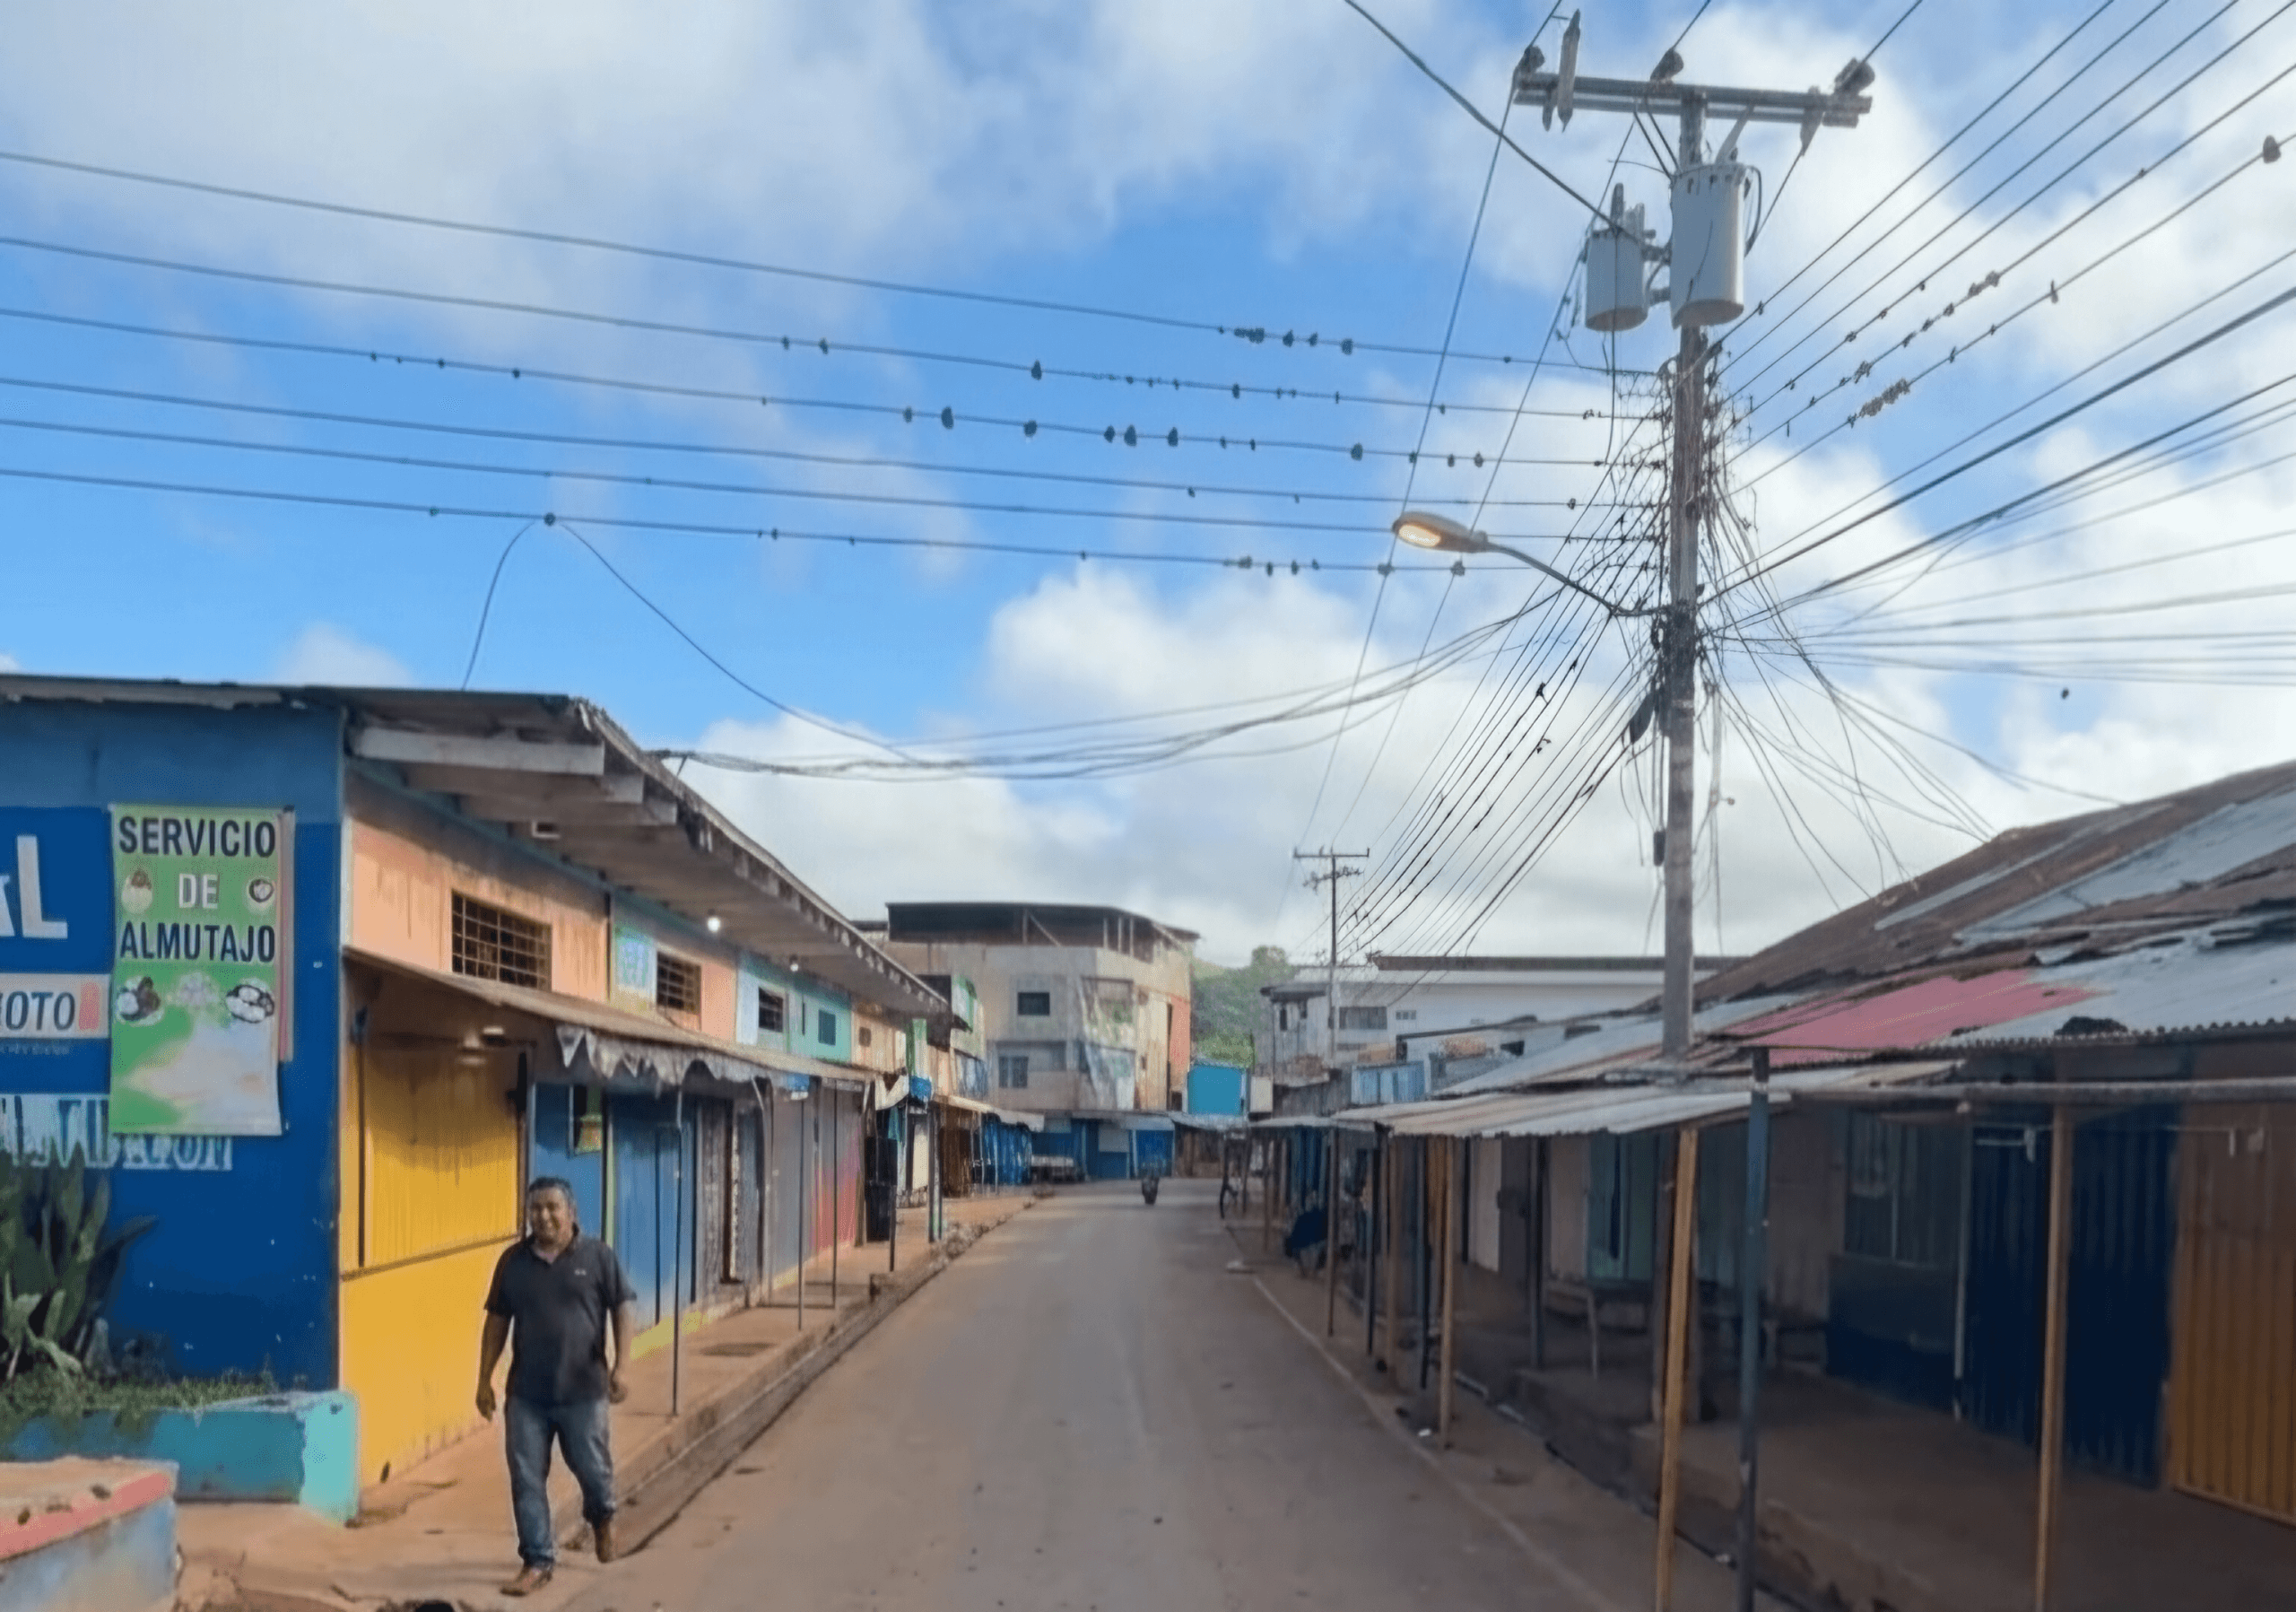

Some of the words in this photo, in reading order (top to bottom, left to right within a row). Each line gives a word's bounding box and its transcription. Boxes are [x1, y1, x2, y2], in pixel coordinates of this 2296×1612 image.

[118, 816, 276, 858] SERVICIO
[178, 873, 220, 910] DE
[119, 920, 275, 963] ALMUTAJO
[0, 990, 76, 1032] OTO
